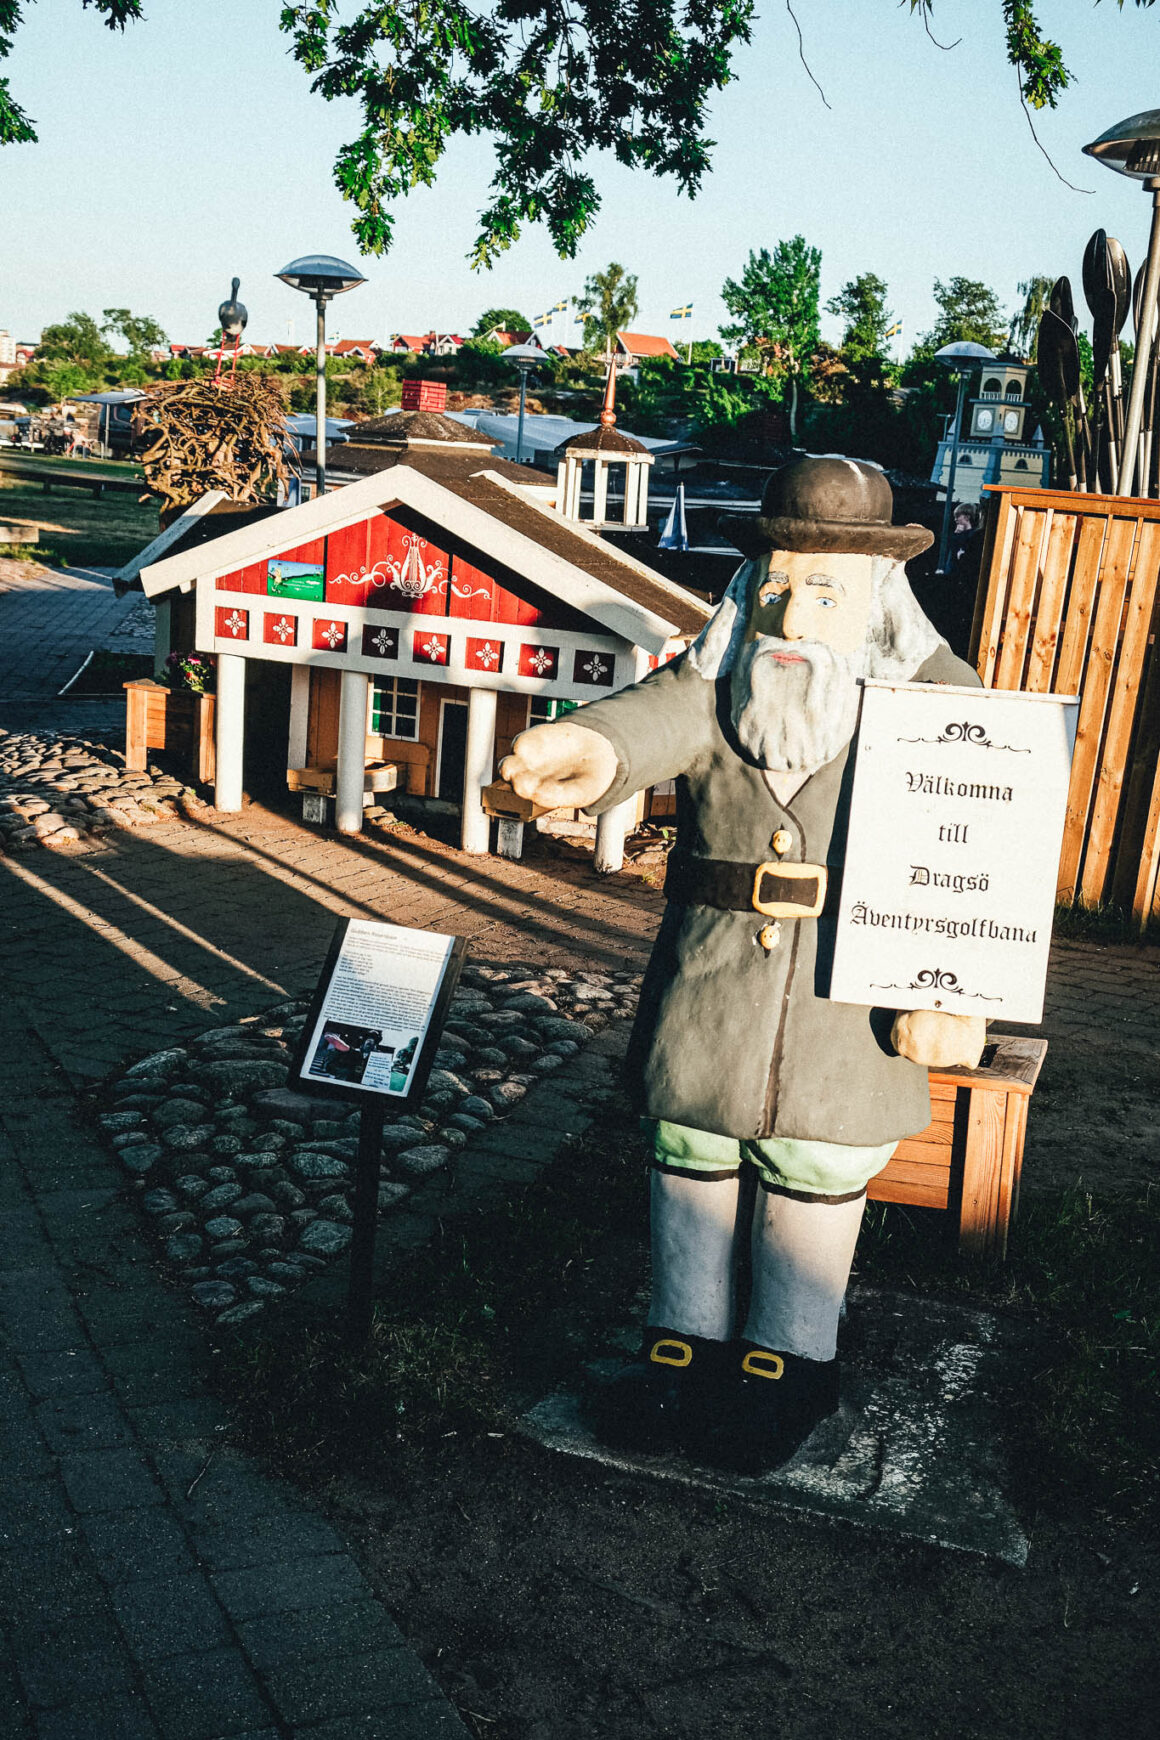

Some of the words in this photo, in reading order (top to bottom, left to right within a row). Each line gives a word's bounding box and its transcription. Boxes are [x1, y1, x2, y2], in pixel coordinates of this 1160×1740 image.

[905, 771, 1014, 802] Välkomna
[938, 823, 969, 844] till
[909, 865, 990, 894] Dragsö
[849, 901, 1037, 944] Äventyrsgolfbana
